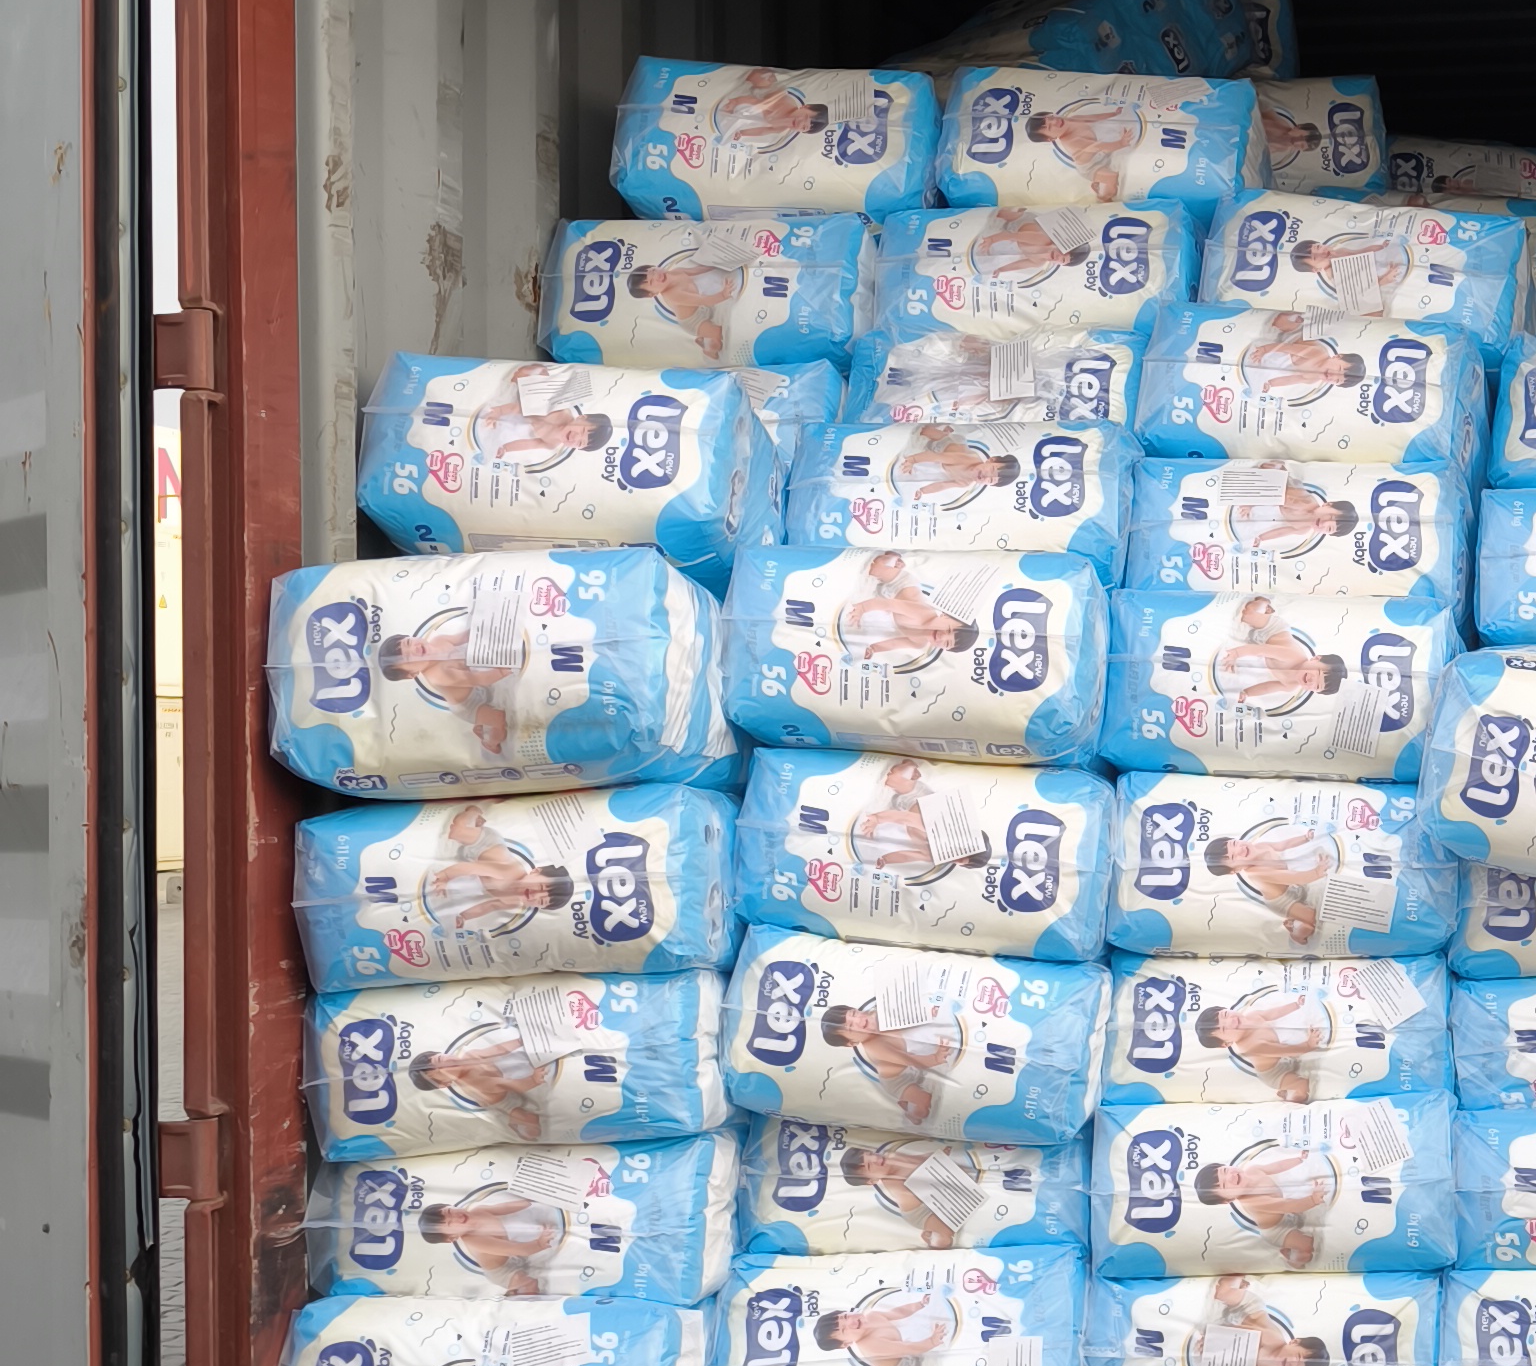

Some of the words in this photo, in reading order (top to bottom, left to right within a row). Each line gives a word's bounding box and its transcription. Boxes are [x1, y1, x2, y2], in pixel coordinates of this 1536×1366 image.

[1021, 91, 1035, 115] baby
[646, 143, 668, 170] 56
[821, 130, 836, 160] baby
[662, 196, 681, 213] 2
[1286, 217, 1303, 243] baby
[621, 242, 638, 270] baby
[763, 277, 789, 298] M
[1084, 260, 1098, 292] baby
[907, 288, 927, 315] 56
[422, 402, 454, 427] M
[1171, 396, 1193, 424] 56
[1357, 384, 1372, 417] baby
[1412, 392, 1422, 413] new
[393, 462, 418, 494] 56
[603, 446, 619, 483] baby
[665, 452, 675, 475] new
[842, 456, 870, 477] M
[1014, 480, 1029, 513] baby
[1071, 484, 1081, 504] new
[414, 524, 436, 542] 2
[819, 512, 842, 539] 56
[1353, 532, 1367, 566] baby
[1409, 537, 1418, 558] new
[1160, 555, 1184, 584] 56
[578, 569, 606, 601] 56
[370, 604, 383, 643] baby
[785, 599, 815, 627] M
[551, 644, 584, 672] M
[970, 648, 987, 685] baby
[1034, 654, 1043, 677] new
[761, 664, 786, 697] 56
[1141, 708, 1166, 740] 56
[799, 805, 829, 834] M
[1195, 808, 1213, 842] baby
[982, 866, 1000, 903] baby
[1044, 874, 1054, 898] new
[353, 946, 385, 974] 56
[611, 981, 638, 1013] 56
[814, 971, 834, 1007] baby
[1021, 979, 1049, 1009] 56
[397, 1021, 414, 1060] baby
[584, 1055, 617, 1082] M
[985, 1043, 1017, 1074] M
[1185, 1134, 1200, 1170] baby
[622, 1153, 651, 1183] 56
[1361, 1175, 1392, 1204] M
[589, 1223, 622, 1253] M
[1495, 1232, 1523, 1262] 56
